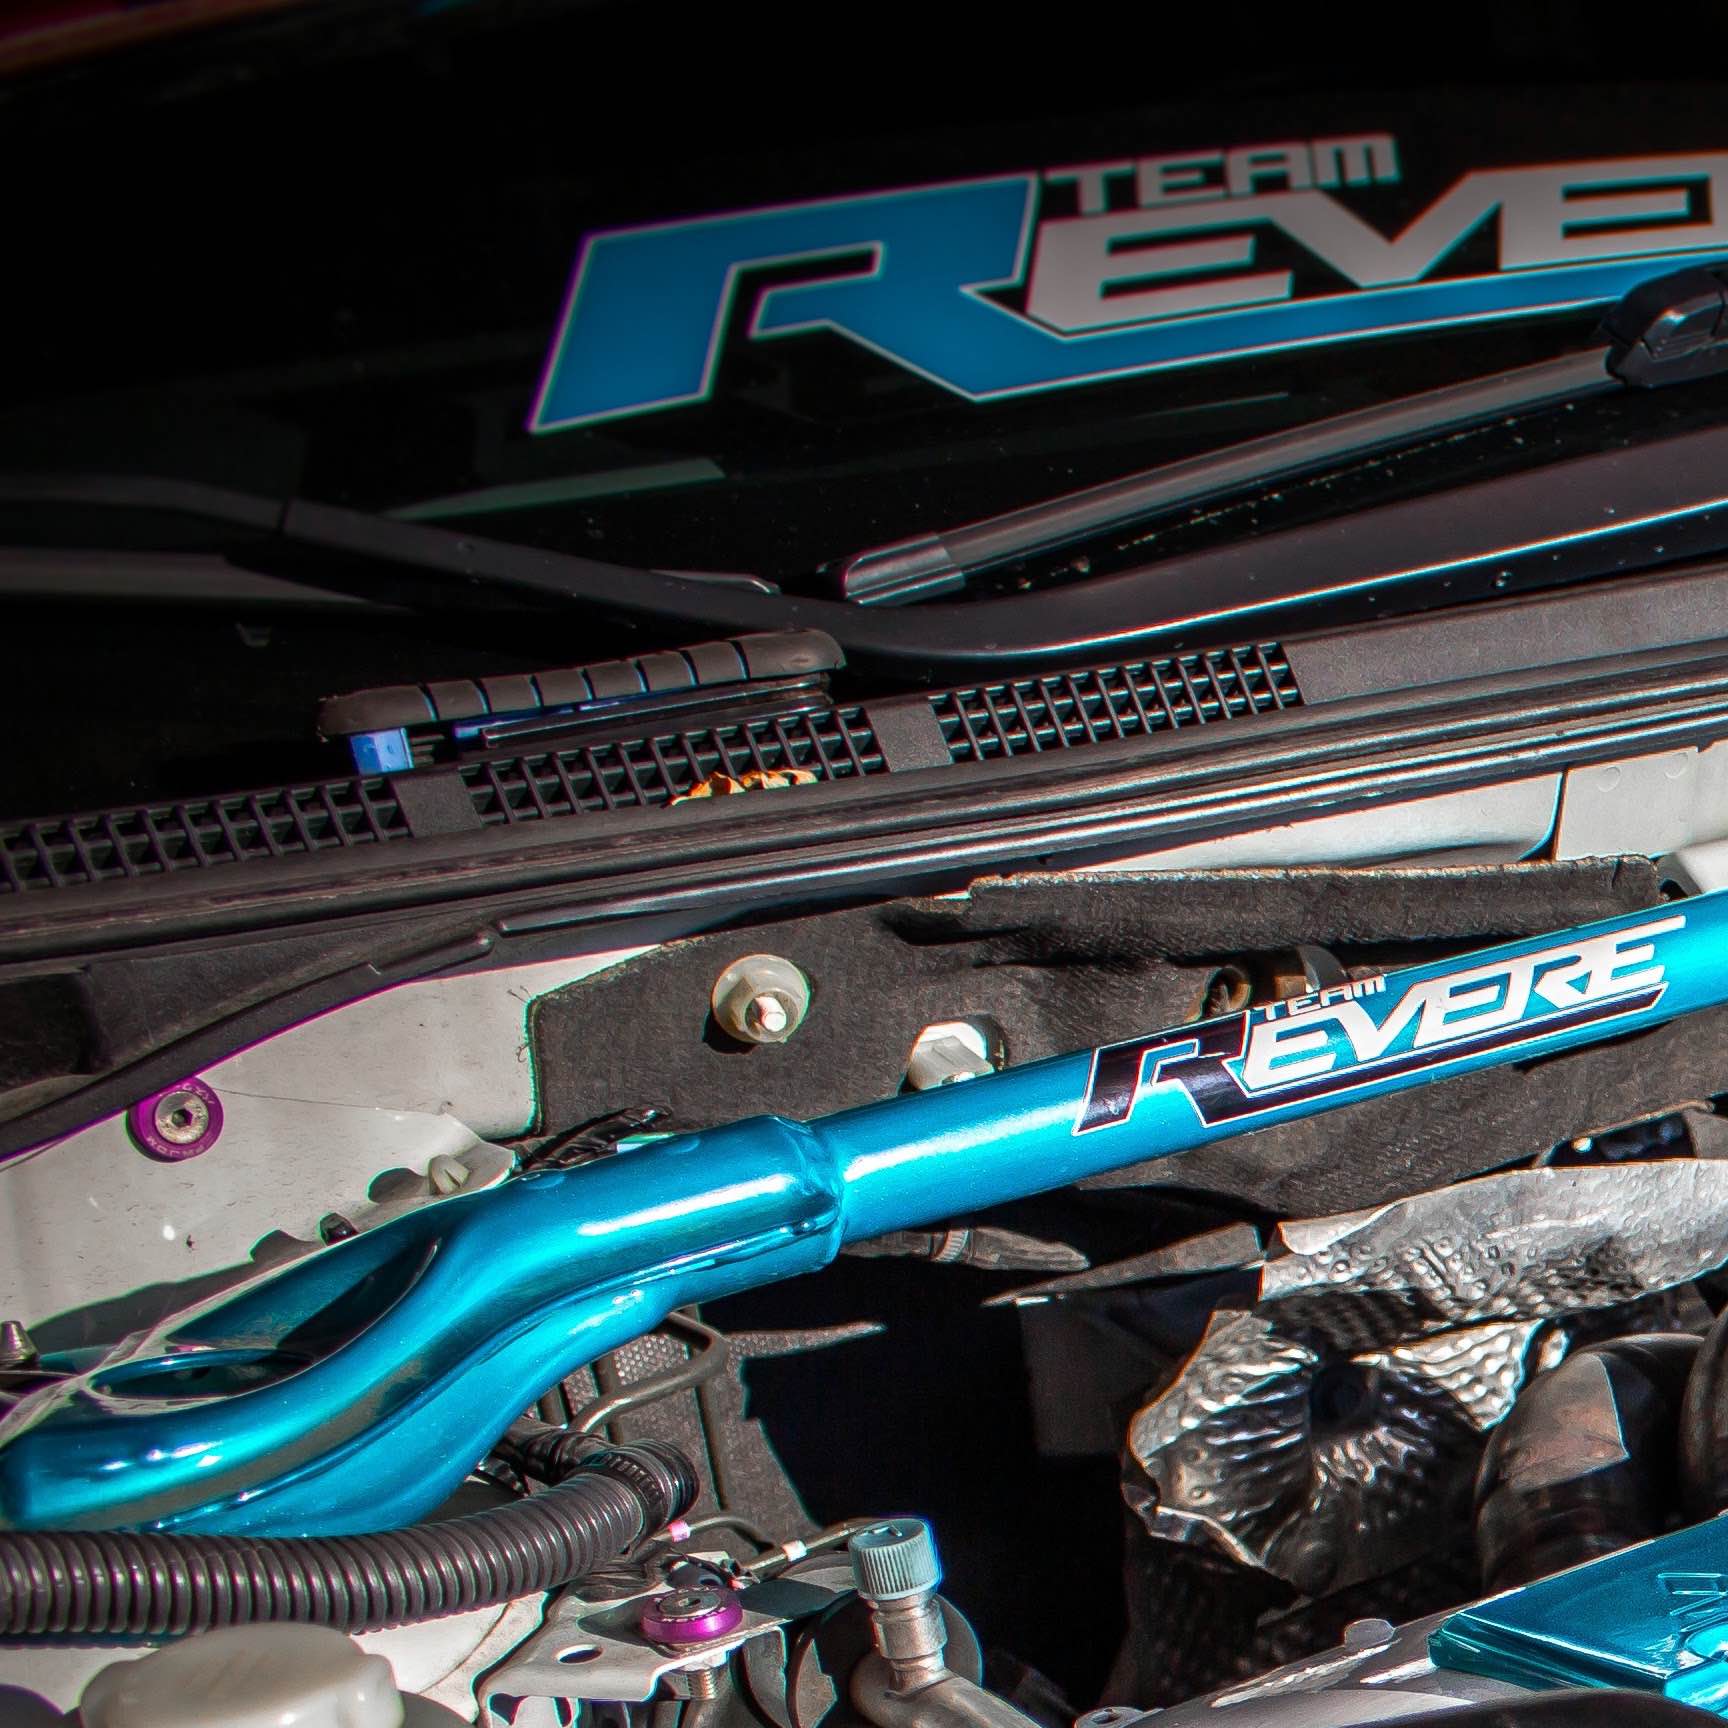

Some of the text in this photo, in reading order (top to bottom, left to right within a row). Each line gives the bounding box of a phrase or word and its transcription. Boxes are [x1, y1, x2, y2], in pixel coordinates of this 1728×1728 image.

[1044, 135, 1400, 216] TEAM
[1072, 915, 1687, 1136] REVERE
[1260, 976, 1387, 1020] TEAM
